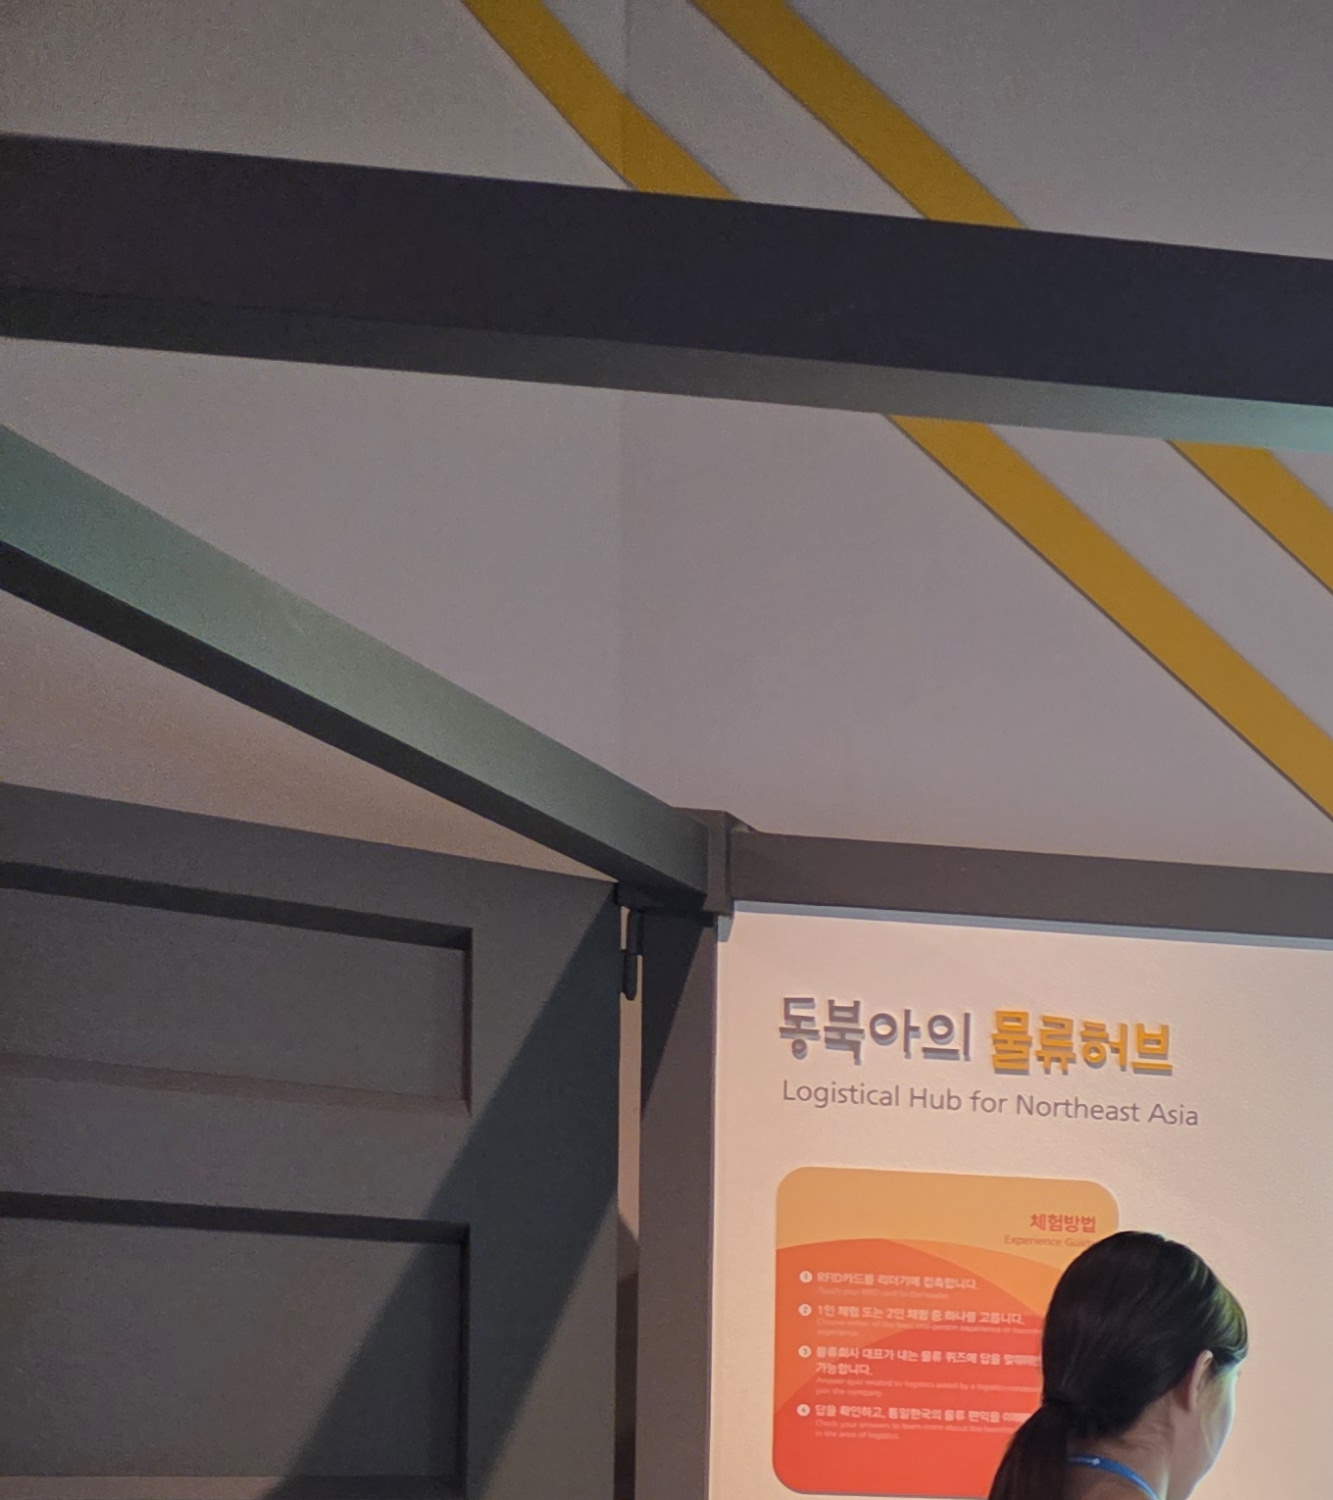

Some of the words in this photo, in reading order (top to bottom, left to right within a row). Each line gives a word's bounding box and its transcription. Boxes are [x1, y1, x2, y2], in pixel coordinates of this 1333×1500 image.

[779, 997, 972, 1066] 동북아의
[989, 1009, 1174, 1076] 물류허브
[782, 1079, 899, 1109] Logistical
[908, 1087, 963, 1112] Hub
[970, 1089, 1008, 1114] for
[1016, 1093, 1141, 1124] Northeast
[1147, 1102, 1200, 1127] Asia
[1030, 1213, 1096, 1234] 체험방법
